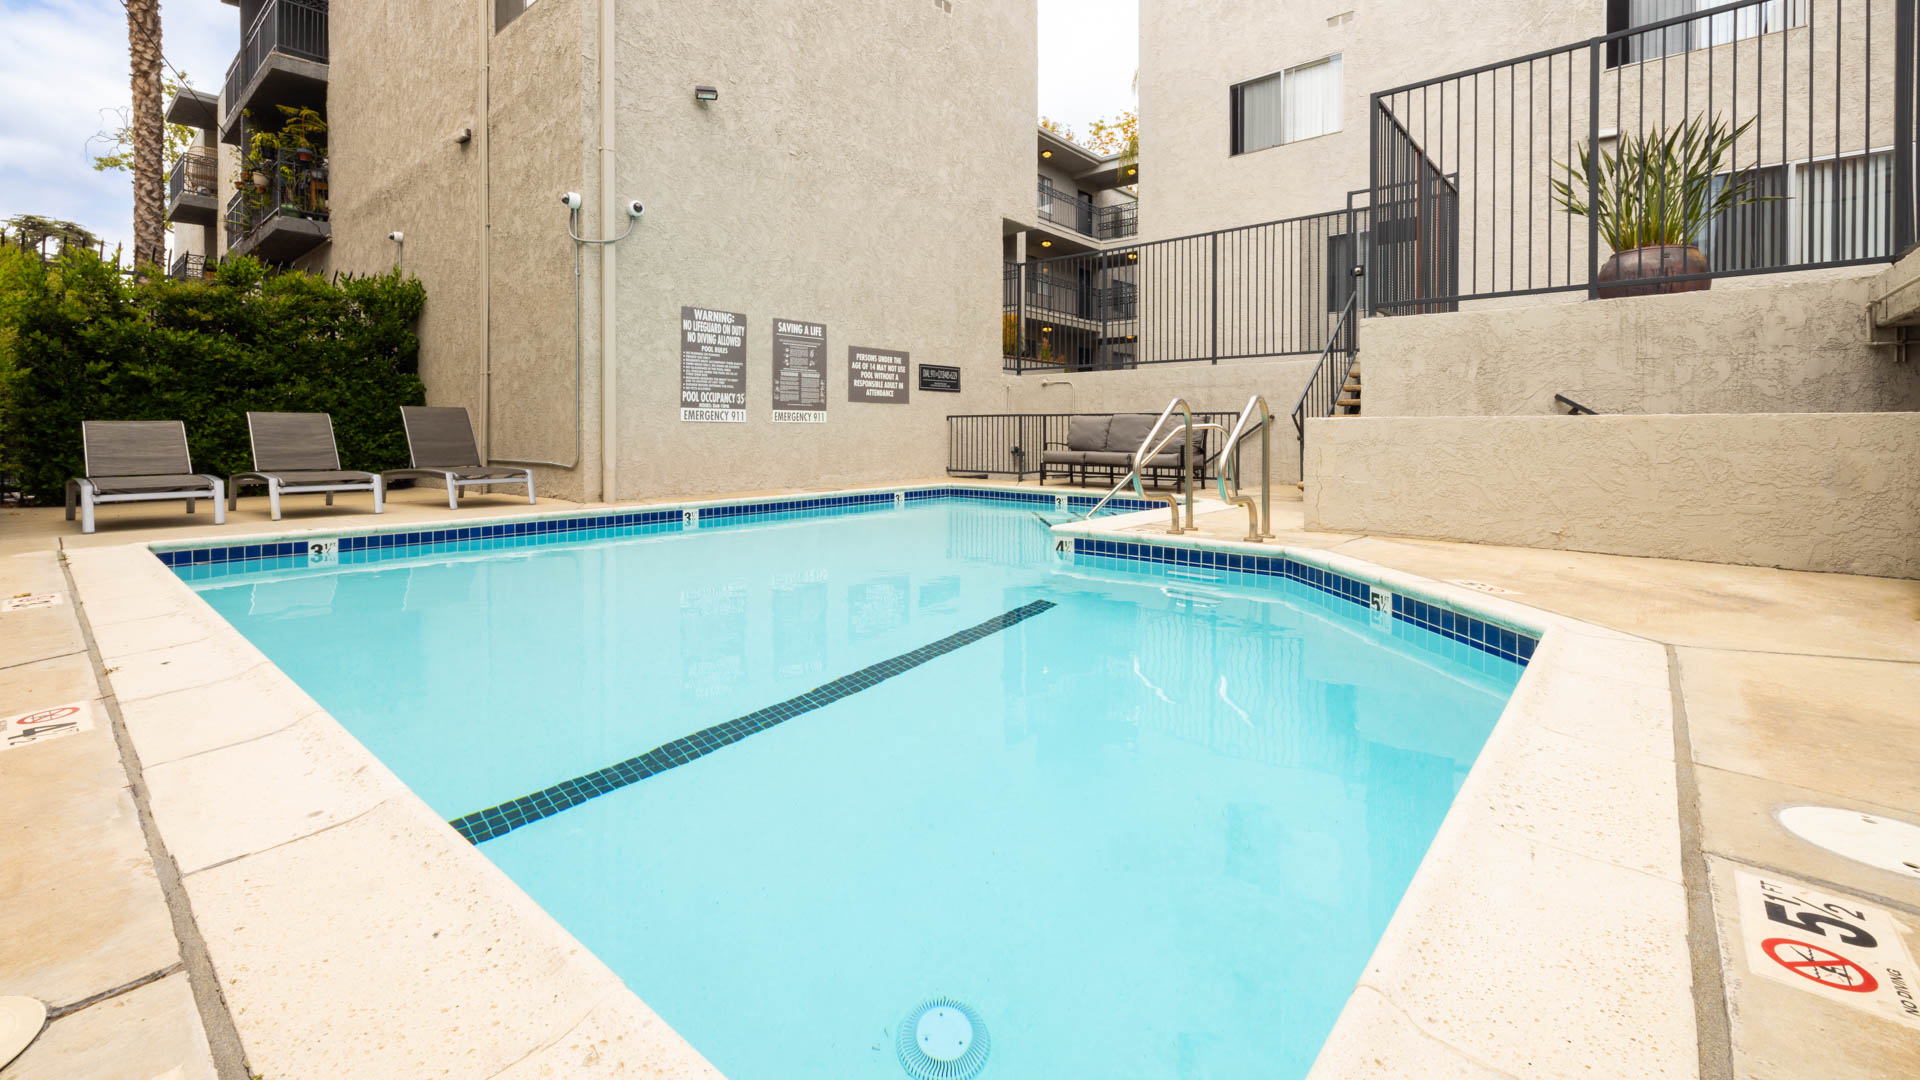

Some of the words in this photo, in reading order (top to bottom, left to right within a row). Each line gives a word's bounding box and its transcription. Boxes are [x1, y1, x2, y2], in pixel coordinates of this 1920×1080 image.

[694, 309, 735, 324] WARNING:
[683, 319, 692, 331] NO
[693, 320, 722, 334] LIFEGUARD
[722, 324, 731, 335] ON
[731, 325, 745, 337] DUTY
[778, 321, 803, 335] SAVING
[804, 325, 810, 336] A
[810, 326, 822, 337] LIFE
[687, 331, 696, 343] NO
[697, 332, 717, 345] DIVING
[717, 334, 741, 347] ALLOWED
[701, 345, 714, 353] POOL
[714, 346, 728, 354] RULES
[856, 353, 877, 362] PERSONS
[878, 355, 893, 364] UNDER
[893, 356, 902, 365] THE
[851, 361, 861, 370] AGE
[862, 362, 868, 370] OF
[877, 363, 887, 371] MAY
[888, 364, 897, 372] NOT
[898, 365, 906, 374] USE
[860, 371, 873, 379] POOL
[874, 372, 895, 381] WITHOUT
[854, 379, 884, 388] RESPONSIBLE
[884, 381, 898, 390] ADULT
[898, 382, 904, 390] IN
[682, 390, 699, 403] POOL
[700, 391, 736, 404] OCCUPANCY
[736, 393, 745, 405] 35
[865, 388, 894, 398] ATTENDANCE
[684, 410, 729, 421] EMERGENCY
[731, 410, 744, 421] 911
[774, 411, 811, 422] EMERGENCY
[813, 412, 825, 422] 911
[1371, 591, 1380, 611] 5
[1764, 900, 1878, 948] 5
[1886, 968, 1914, 1001] DIVING
[1900, 999, 1920, 1017] NO
